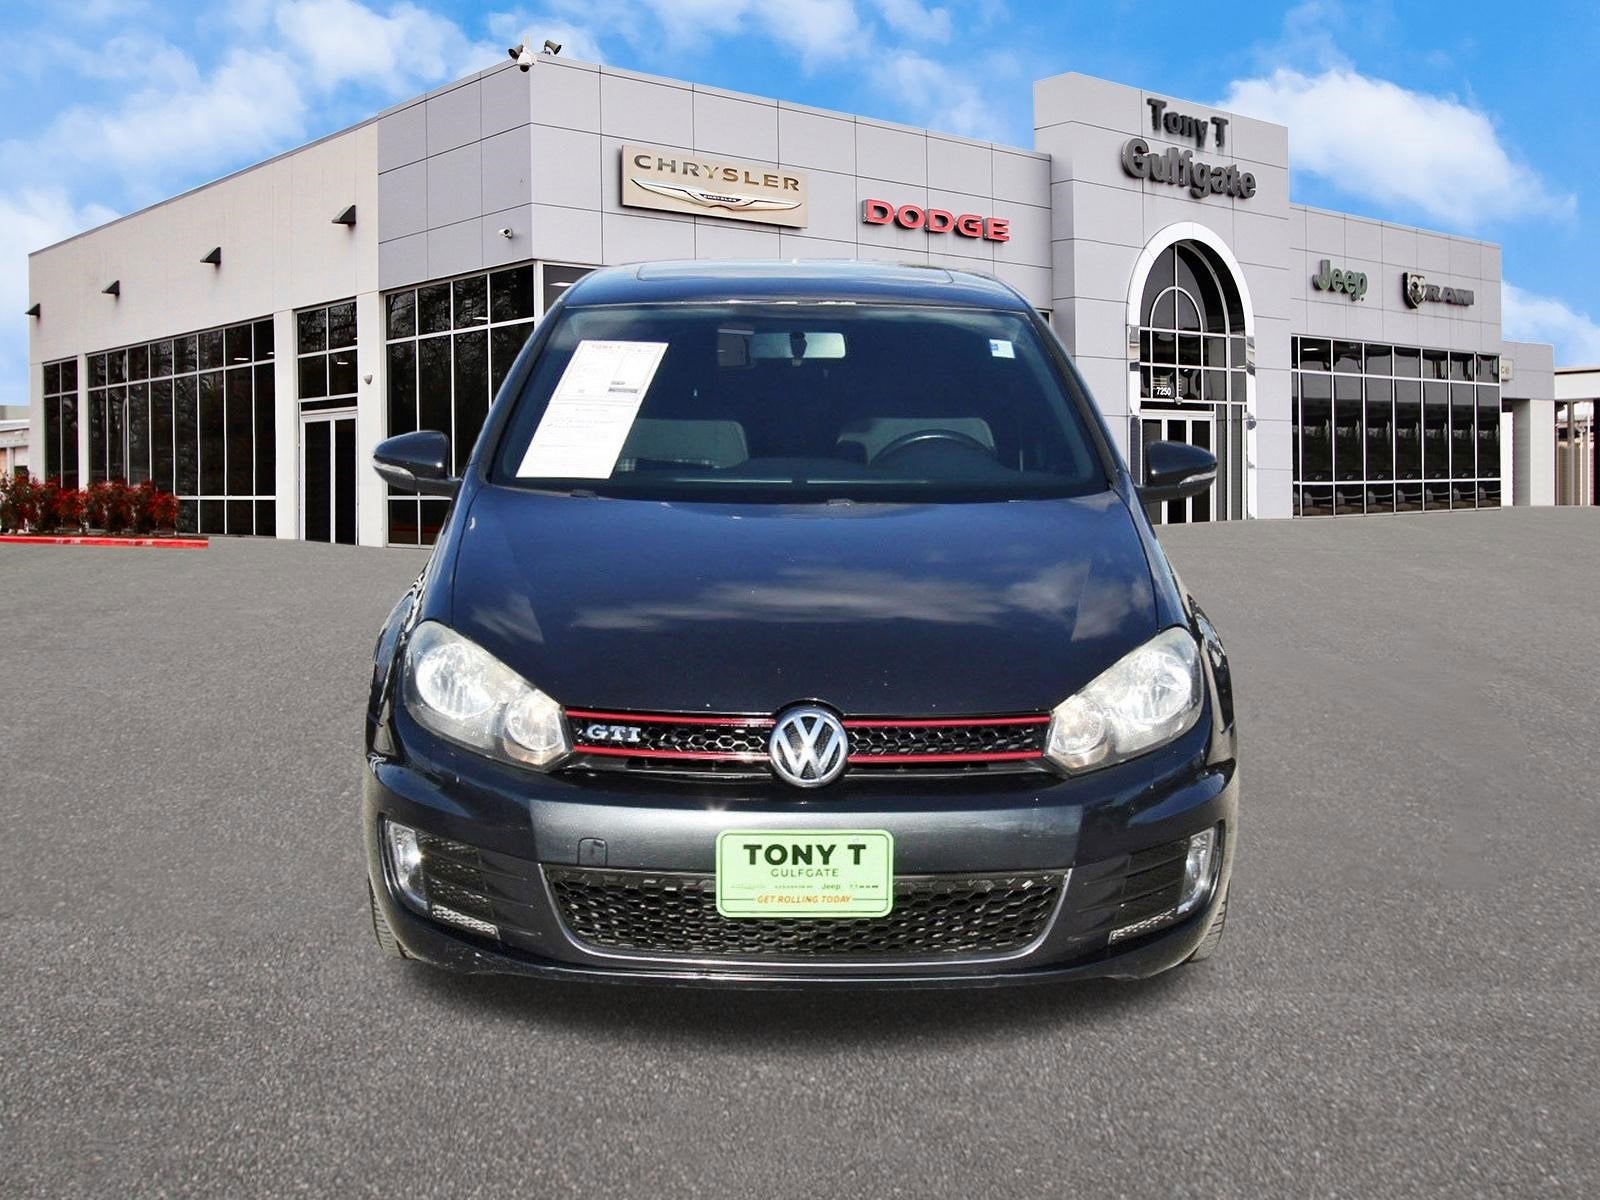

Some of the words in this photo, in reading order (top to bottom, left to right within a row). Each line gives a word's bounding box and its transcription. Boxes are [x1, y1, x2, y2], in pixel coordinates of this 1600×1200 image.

[1146, 98, 1208, 148] Tony
[1210, 116, 1229, 147] T
[634, 154, 800, 191] CHRYSLER
[1121, 138, 1257, 199] Gulfgate
[863, 199, 1010, 242] DODGE
[1312, 259, 1368, 302] Jeep
[1424, 284, 1474, 306] RAM
[587, 724, 641, 742] GTI
[743, 844, 836, 866] TONY
[847, 844, 867, 865] T
[770, 868, 839, 877] GULFGATE
[757, 895, 776, 904] GET
[777, 895, 819, 904] ROLLING
[821, 895, 852, 904] TODAY
